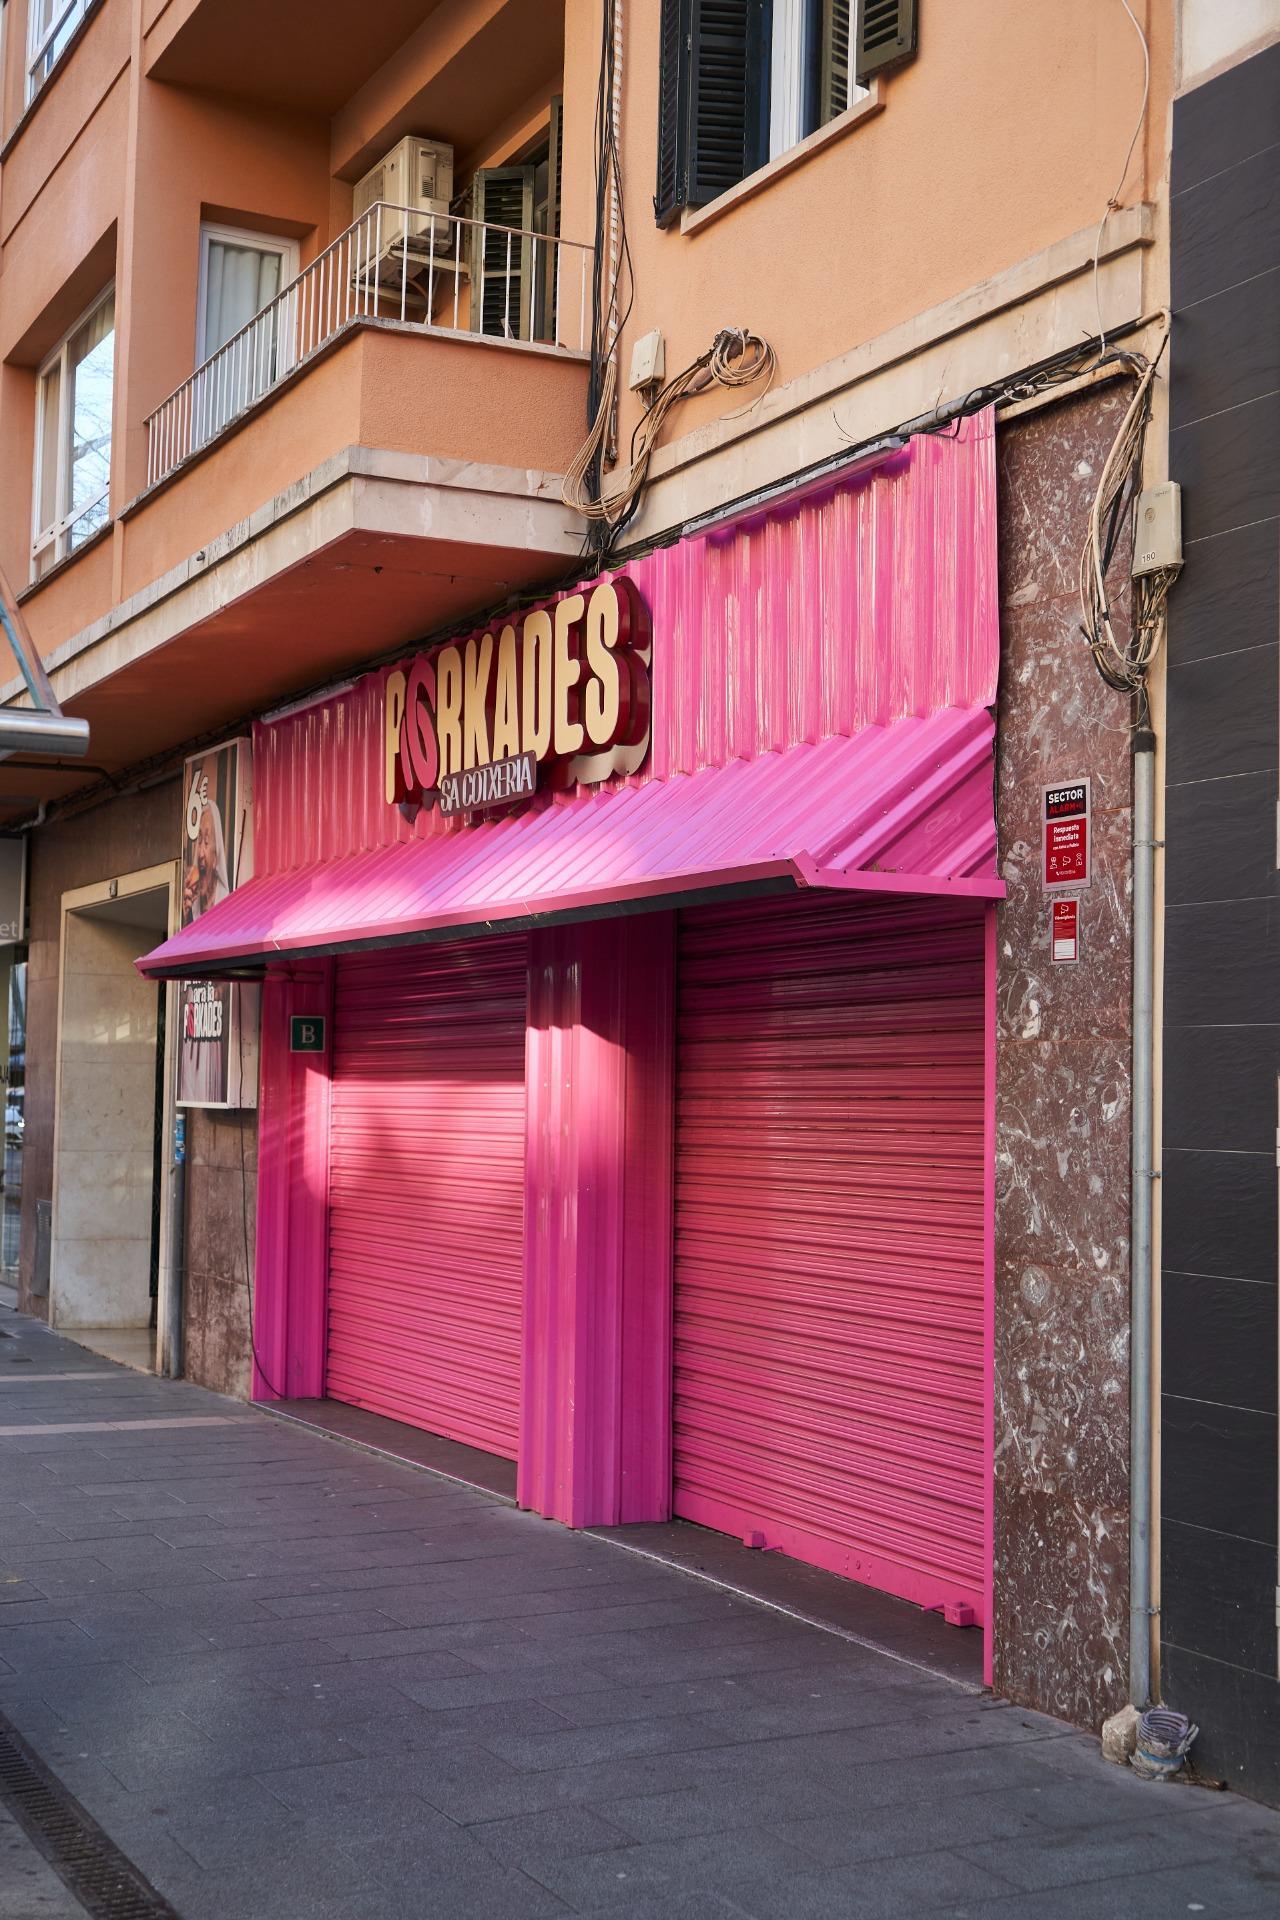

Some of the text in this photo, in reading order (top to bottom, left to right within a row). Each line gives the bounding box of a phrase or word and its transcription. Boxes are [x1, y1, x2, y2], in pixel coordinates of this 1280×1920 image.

[1142, 551, 1156, 563] 180
[386, 582, 620, 804] PORKADES
[440, 756, 533, 811] SA COTXERIA
[186, 769, 209, 840] 6€
[1048, 788, 1084, 804] SECTOR
[1049, 802, 1076, 816] ALARM
[1053, 824, 1080, 834] Respuesta
[183, 1000, 223, 1039] PORKADES
[301, 1024, 315, 1044] B
